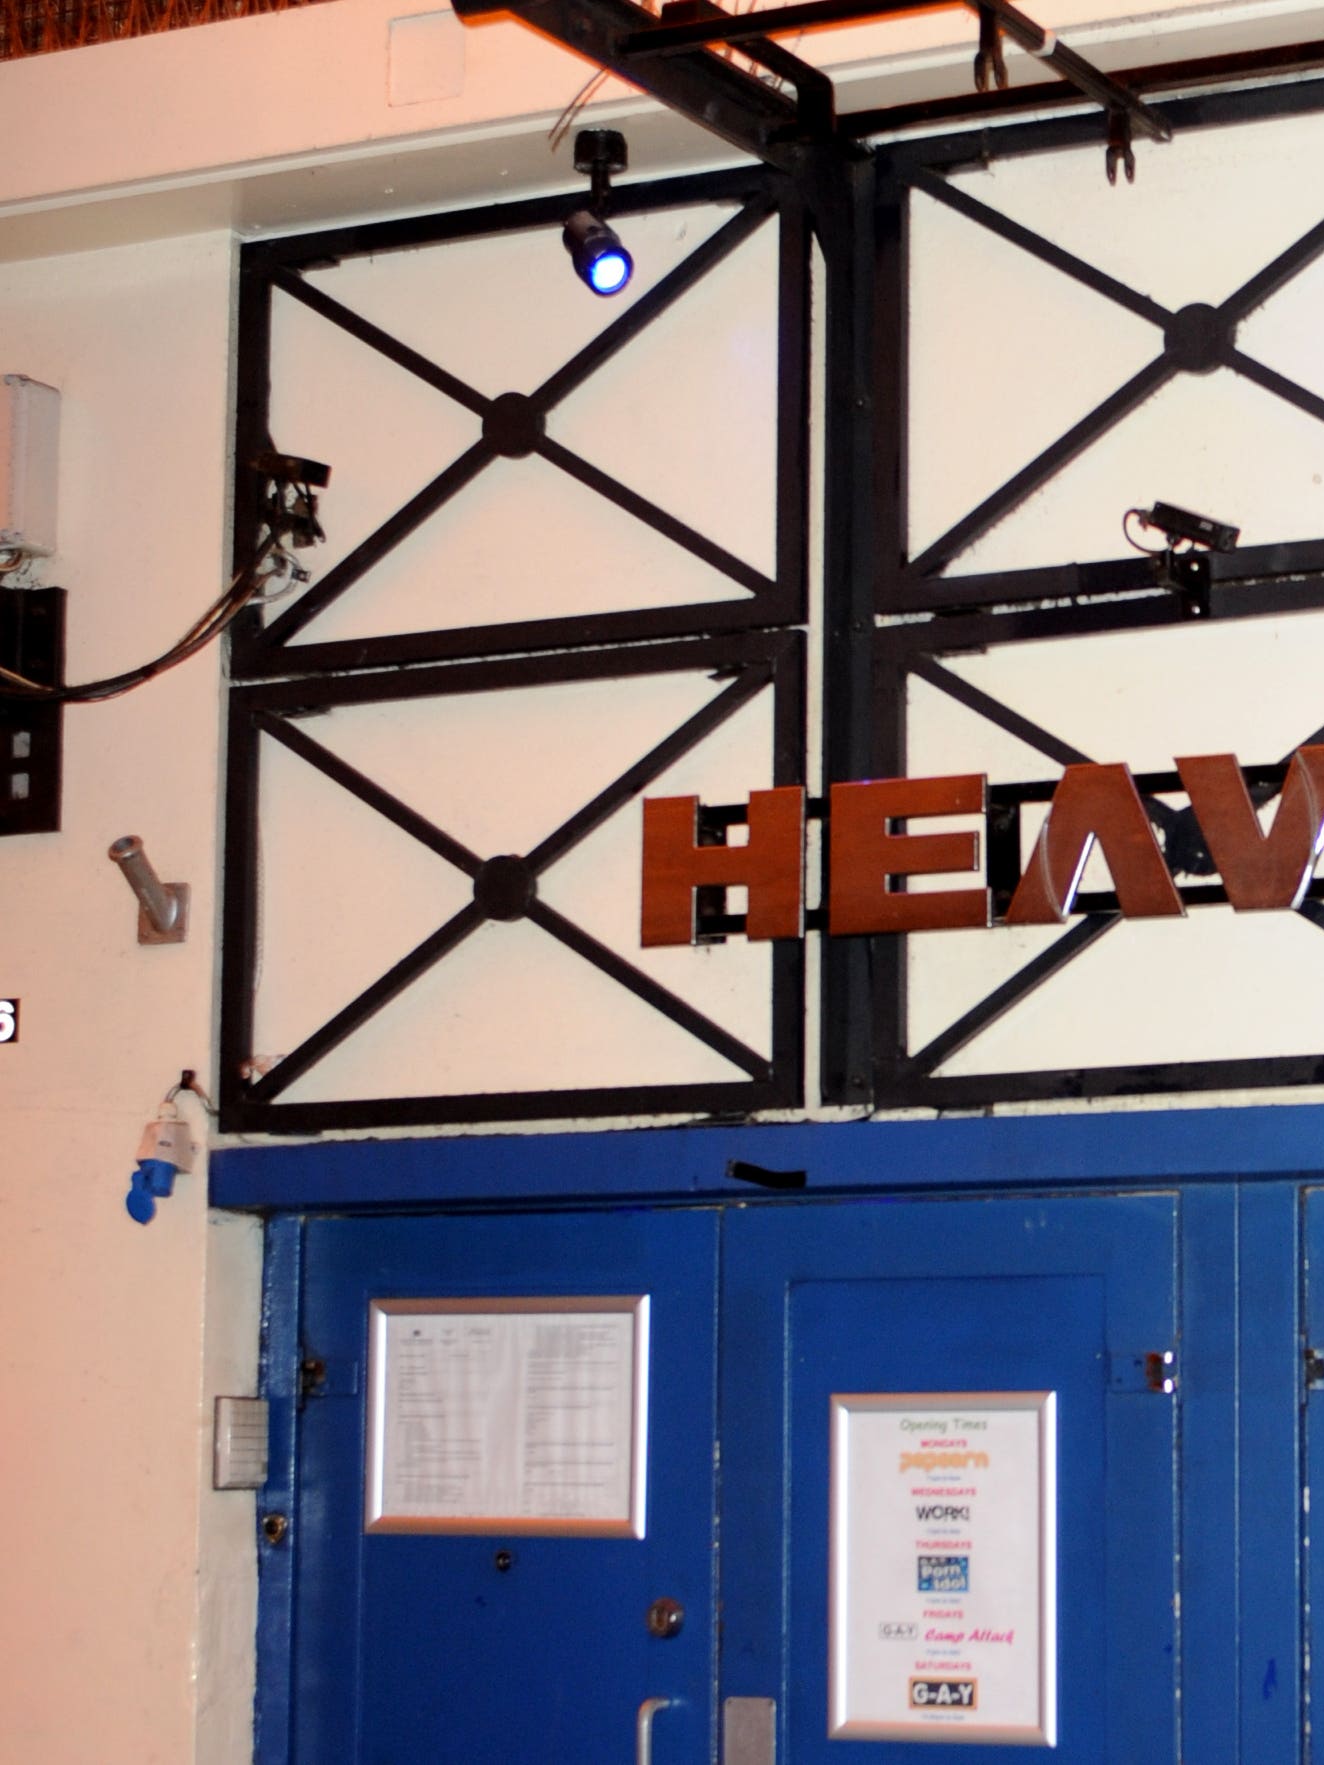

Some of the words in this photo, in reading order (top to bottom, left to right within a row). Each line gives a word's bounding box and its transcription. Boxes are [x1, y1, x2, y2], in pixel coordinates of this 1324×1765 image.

[900, 1418, 949, 1433] Opening
[953, 1418, 988, 1430] Times
[920, 1439, 968, 1448] MONDAYS
[899, 1451, 990, 1473] popcorn
[911, 1487, 977, 1497] WEDNESDAYS
[915, 1504, 970, 1521] WORK!
[915, 1540, 972, 1550] THURSDAYS
[921, 1565, 962, 1578] Porn
[923, 1609, 964, 1619] FRIDAYS
[925, 1629, 965, 1642] Camp
[968, 1629, 1015, 1645] Attack
[915, 1661, 972, 1670] SATURDAYS
[913, 1682, 973, 1705] G-A-Y
